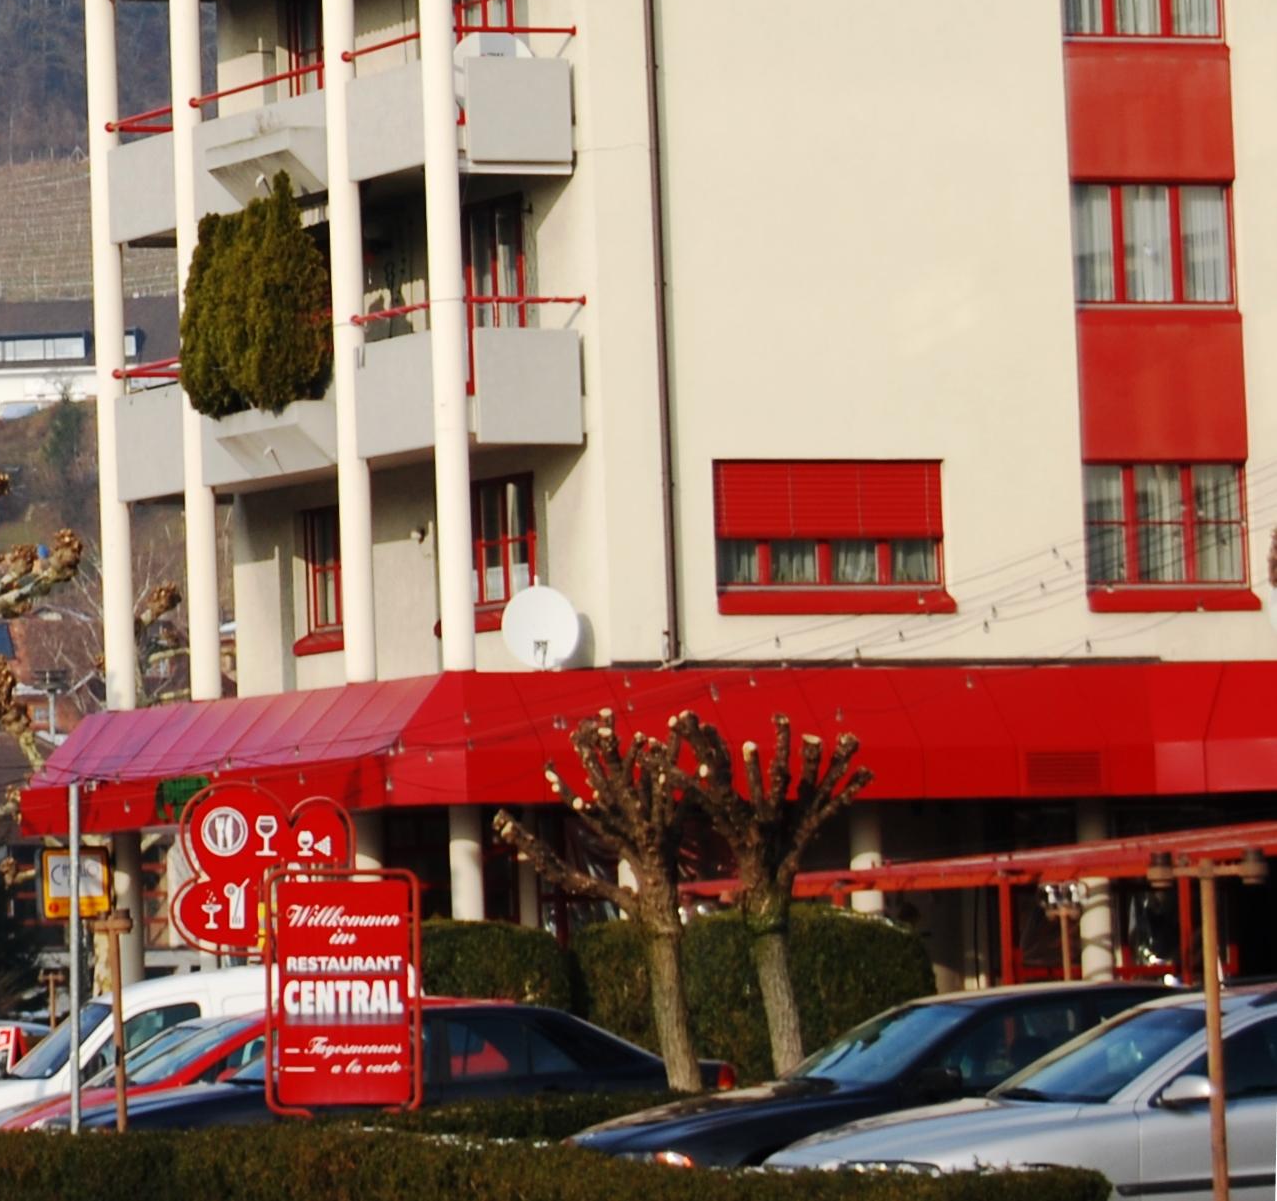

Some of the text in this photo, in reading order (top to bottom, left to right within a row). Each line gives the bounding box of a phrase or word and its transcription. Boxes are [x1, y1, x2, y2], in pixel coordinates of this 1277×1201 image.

[286, 904, 401, 928] Willkommen
[286, 956, 402, 973] RESTAURANT
[283, 979, 404, 1015] CENTRAL
